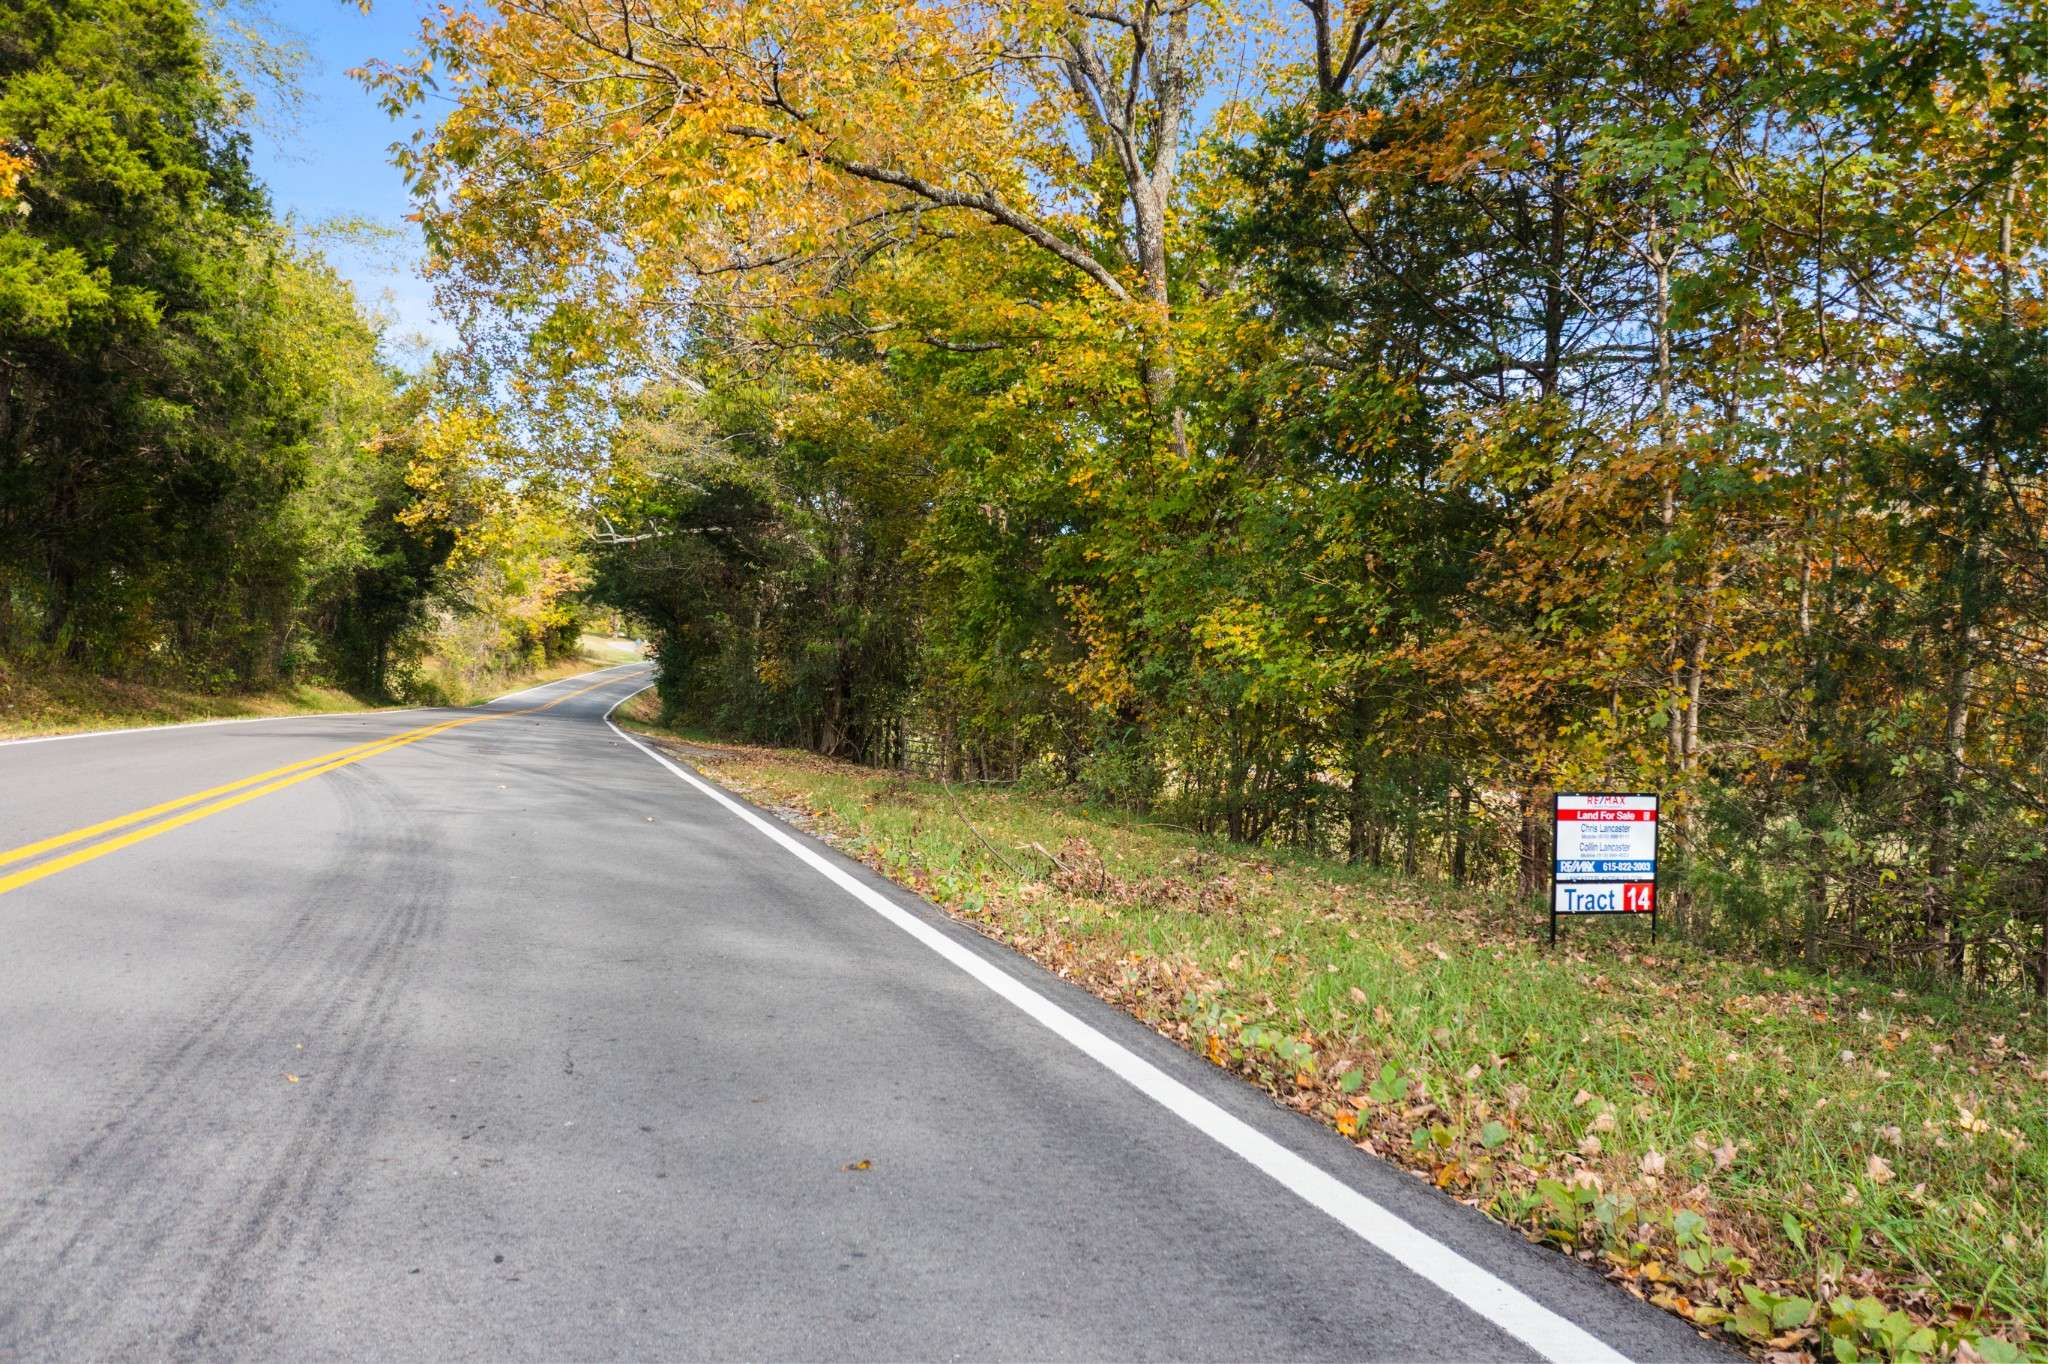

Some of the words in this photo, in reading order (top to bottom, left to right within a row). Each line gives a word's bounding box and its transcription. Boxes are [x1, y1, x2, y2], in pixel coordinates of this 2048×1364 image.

[1587, 796, 1625, 805] RE/MAX
[1577, 811, 1599, 820] Land
[1600, 811, 1615, 820] For
[1617, 811, 1636, 820] Sale
[1580, 823, 1598, 832] Chris
[1600, 823, 1631, 832] Lancaster
[1579, 842, 1598, 852] Collin
[1600, 842, 1631, 852] Lancaster
[1560, 861, 1595, 872] RE/MAX
[1564, 889, 1615, 911] Tract
[1627, 887, 1650, 911] 14
